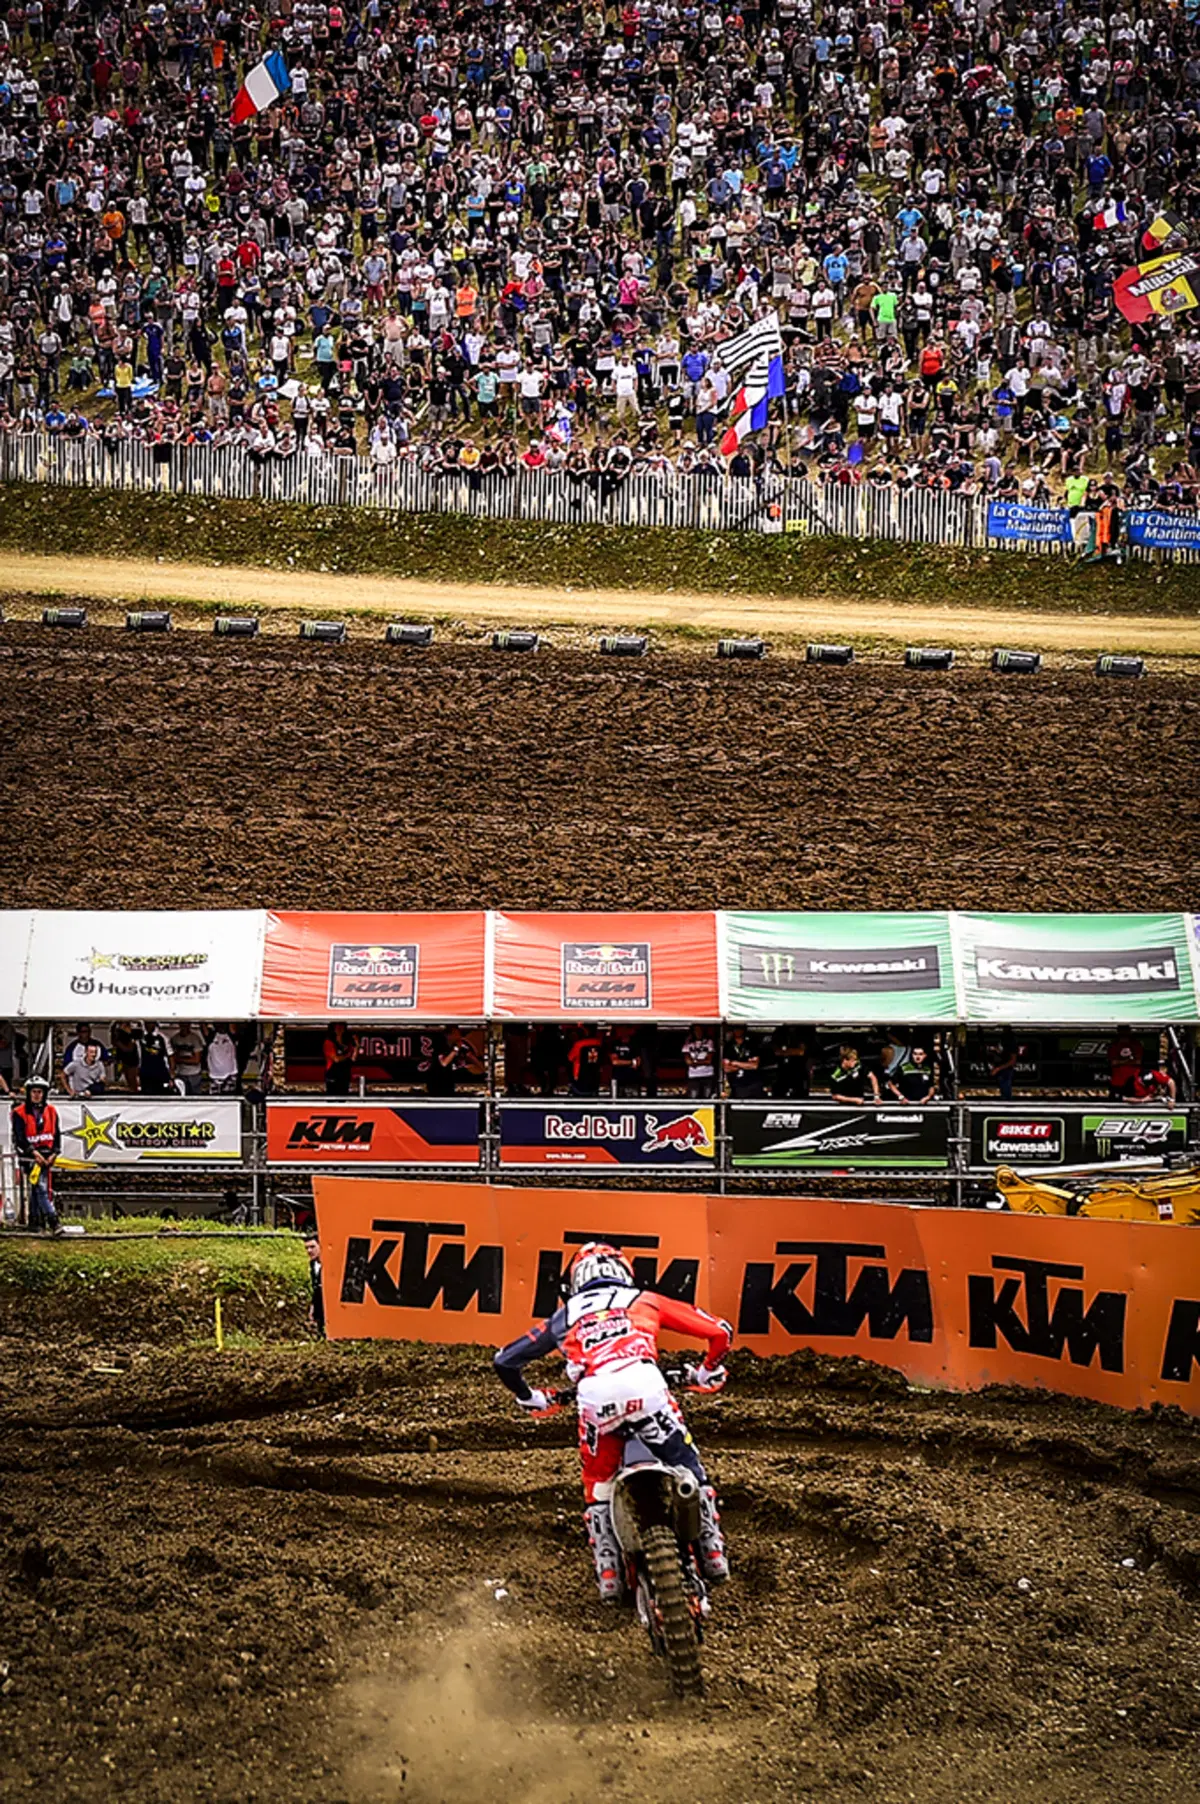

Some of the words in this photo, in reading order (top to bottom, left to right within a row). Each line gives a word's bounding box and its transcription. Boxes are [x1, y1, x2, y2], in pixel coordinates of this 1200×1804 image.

[1008, 506, 1065, 523] Charente
[1006, 519, 1064, 534] Maritime
[809, 958, 926, 973] Kawasaki
[977, 958, 1176, 982] Kawasaki
[98, 982, 211, 996] Husqvarna
[876, 1113, 923, 1123] Kawasaki
[116, 1122, 215, 1139] ROCKSTAR
[289, 1115, 375, 1142] KTM
[1000, 1125, 1033, 1135] BIKE
[1033, 1125, 1049, 1135] IT
[988, 1139, 1060, 1153] Kawasaki
[340, 1218, 504, 1314] KTM
[738, 1241, 934, 1344] KTM
[968, 1254, 1127, 1374] KTM
